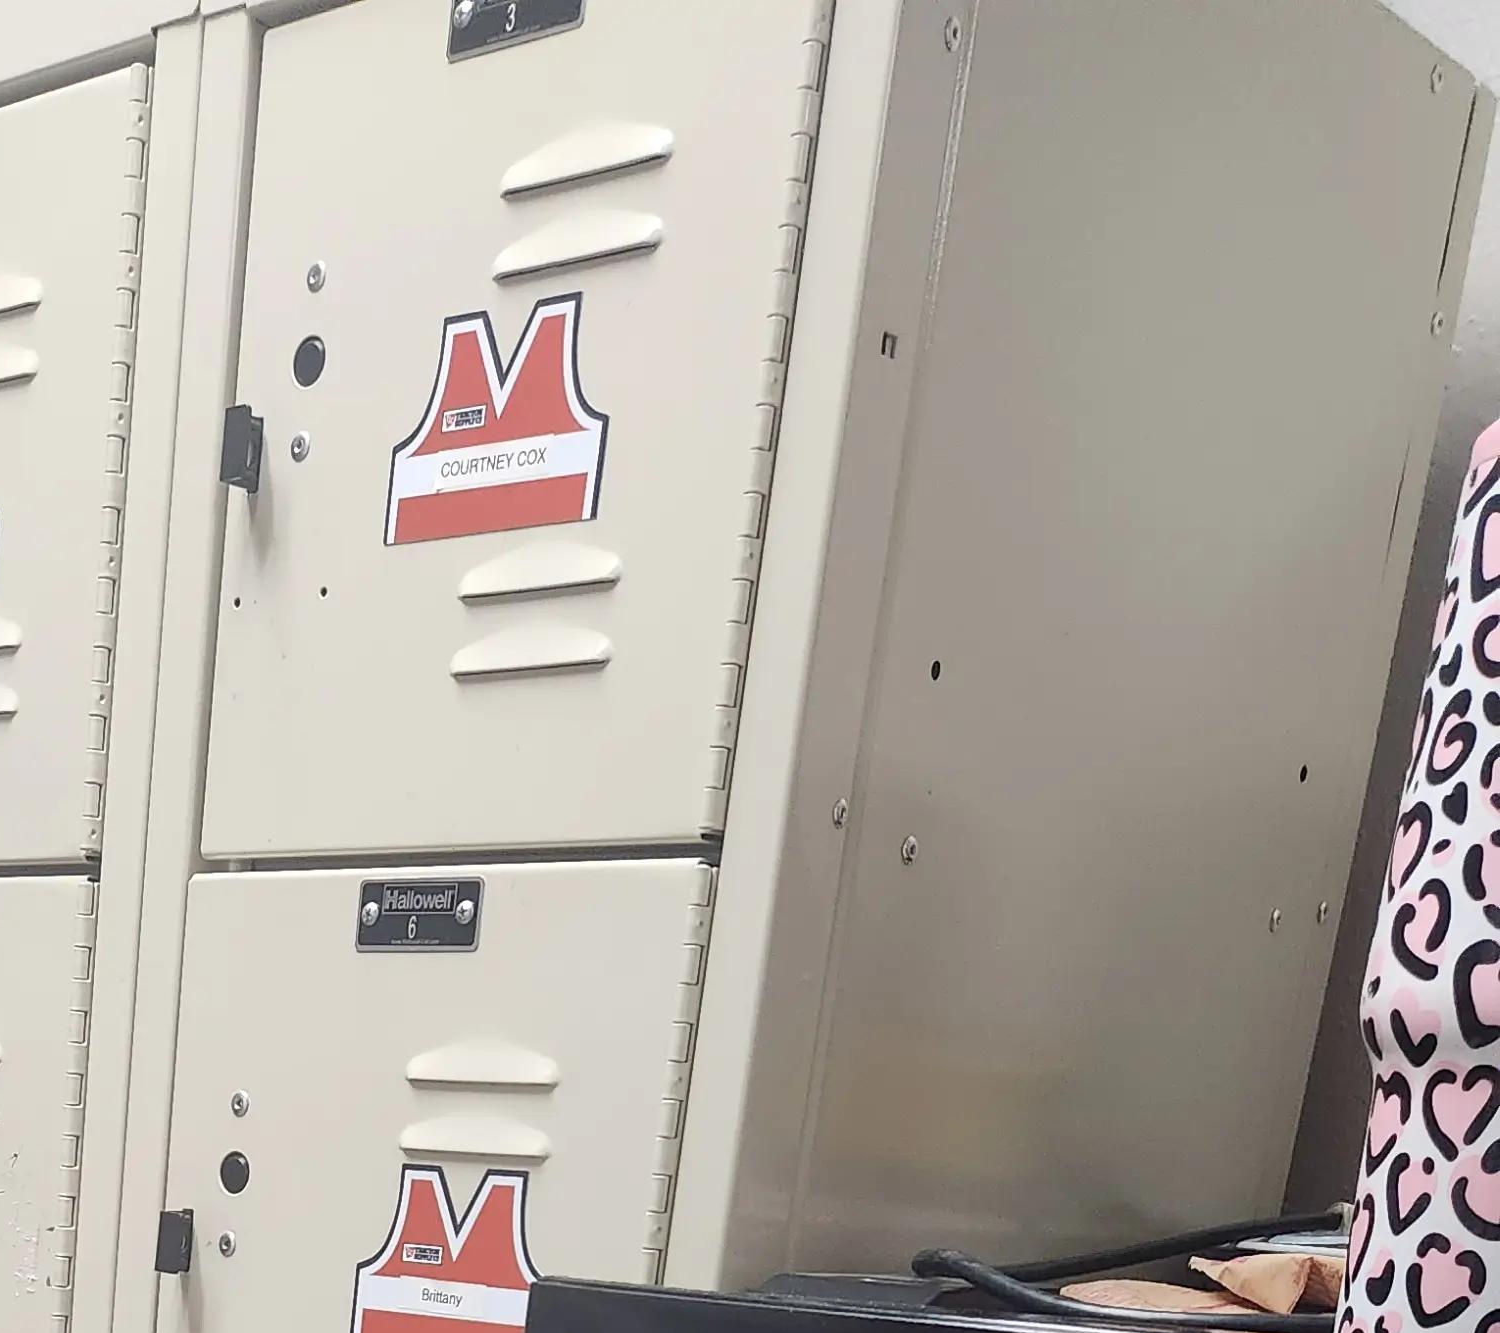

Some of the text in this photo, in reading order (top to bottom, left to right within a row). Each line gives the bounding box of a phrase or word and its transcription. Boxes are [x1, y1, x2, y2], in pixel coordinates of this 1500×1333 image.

[505, 3, 517, 32] 3
[440, 447, 548, 478] COURTNEY COX
[385, 890, 453, 910] Hallowell
[408, 915, 417, 939] 6
[421, 1287, 463, 1308] Brittany
